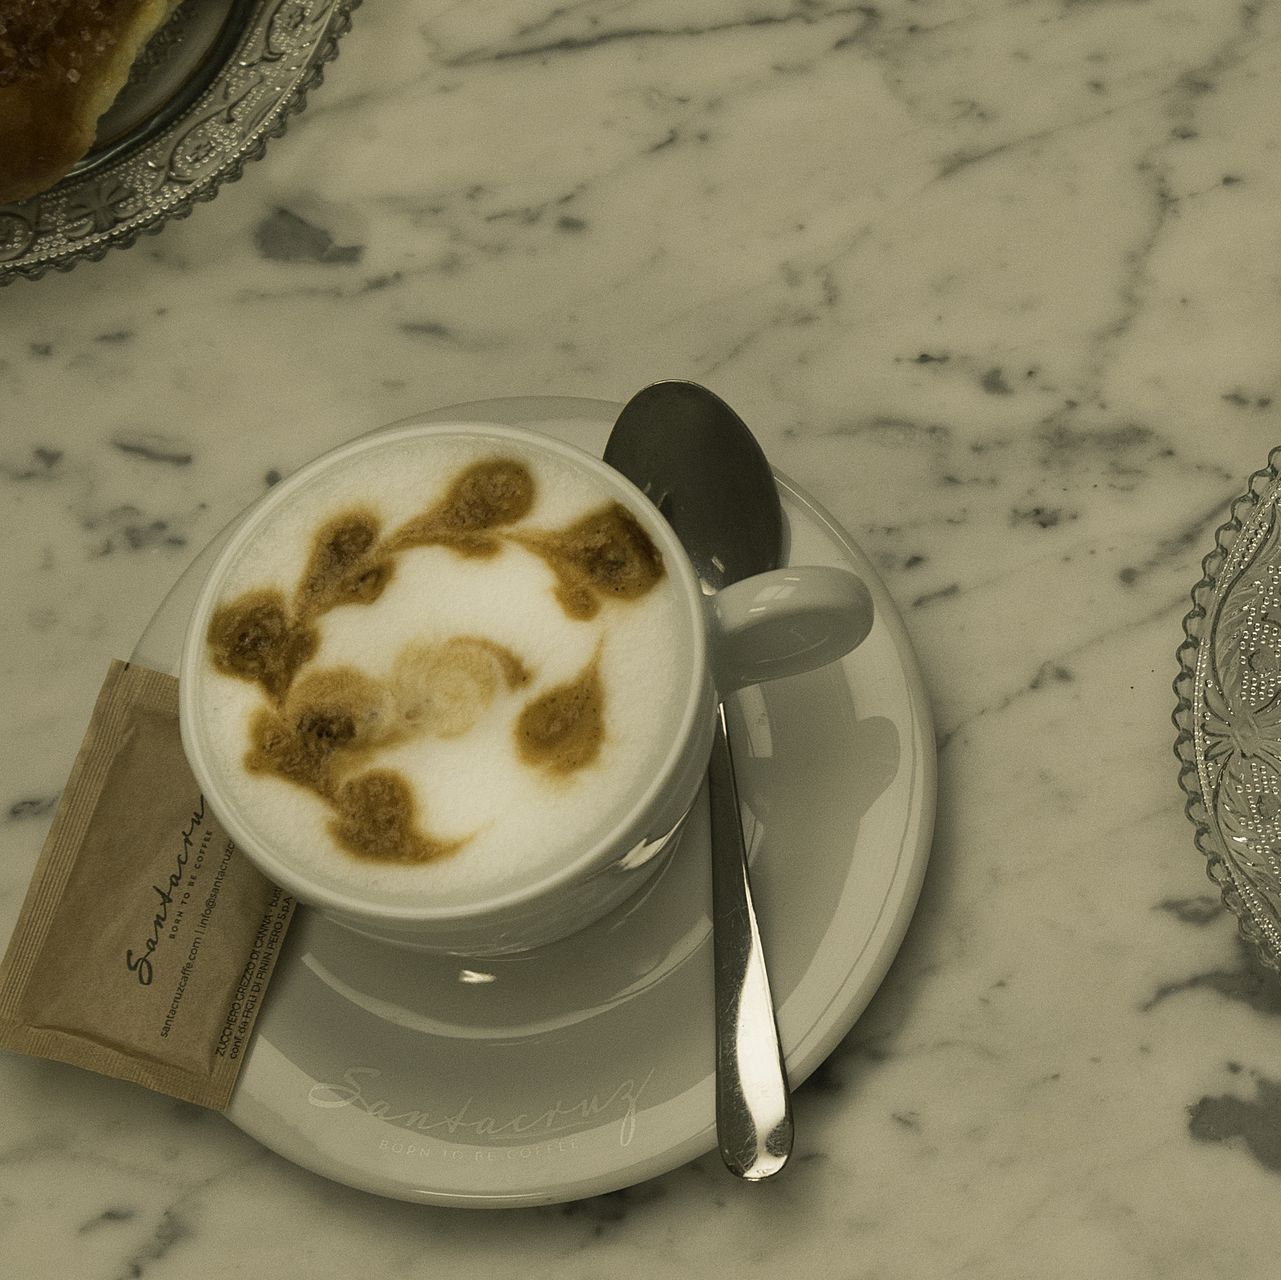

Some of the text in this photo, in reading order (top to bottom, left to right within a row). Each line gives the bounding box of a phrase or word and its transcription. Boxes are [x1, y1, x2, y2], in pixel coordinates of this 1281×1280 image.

[126, 794, 204, 985] Santacru
[161, 936, 203, 1038] santacruzcaffe.com
[200, 839, 236, 931] info@santacruzc
[169, 830, 213, 939] BORN TO BE COFFEE
[215, 1000, 242, 1057] ZUCCHERO
[236, 962, 258, 1001] GREZZO
[250, 949, 260, 961] DI
[252, 981, 263, 994] DI
[267, 921, 285, 951] PERO
[308, 1067, 655, 1148] Santacruz
